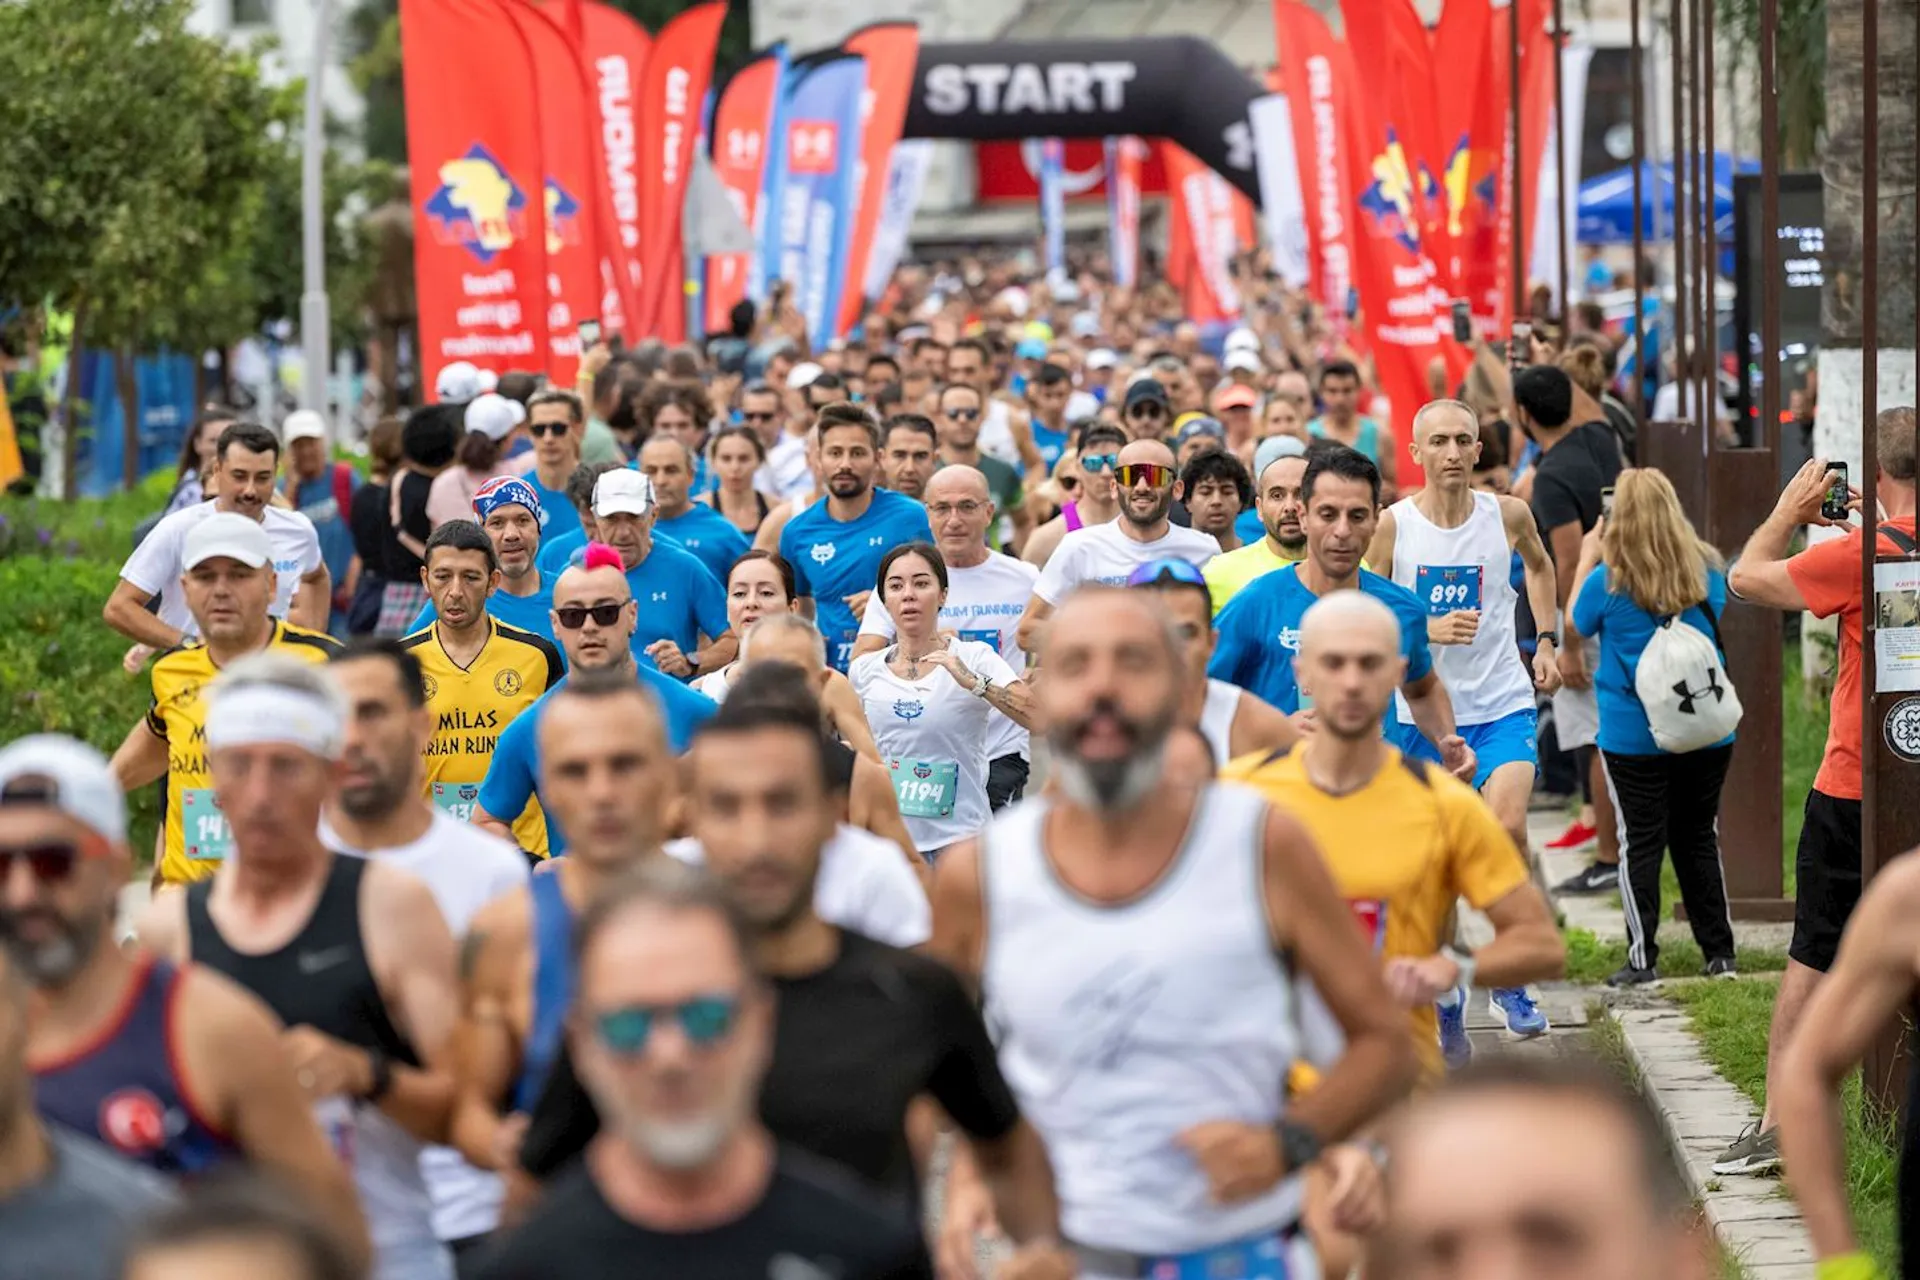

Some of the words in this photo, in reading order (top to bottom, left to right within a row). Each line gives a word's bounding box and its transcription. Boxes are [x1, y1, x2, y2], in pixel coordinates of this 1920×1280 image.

[924, 62, 1137, 116] START
[1430, 584, 1468, 604] 899
[971, 603, 1024, 616] RUNNING
[438, 707, 498, 730] MİLAS
[421, 737, 459, 757] RIAN
[465, 735, 500, 755] RUN
[900, 780, 945, 803] 1194
[448, 803, 477, 823] 13
